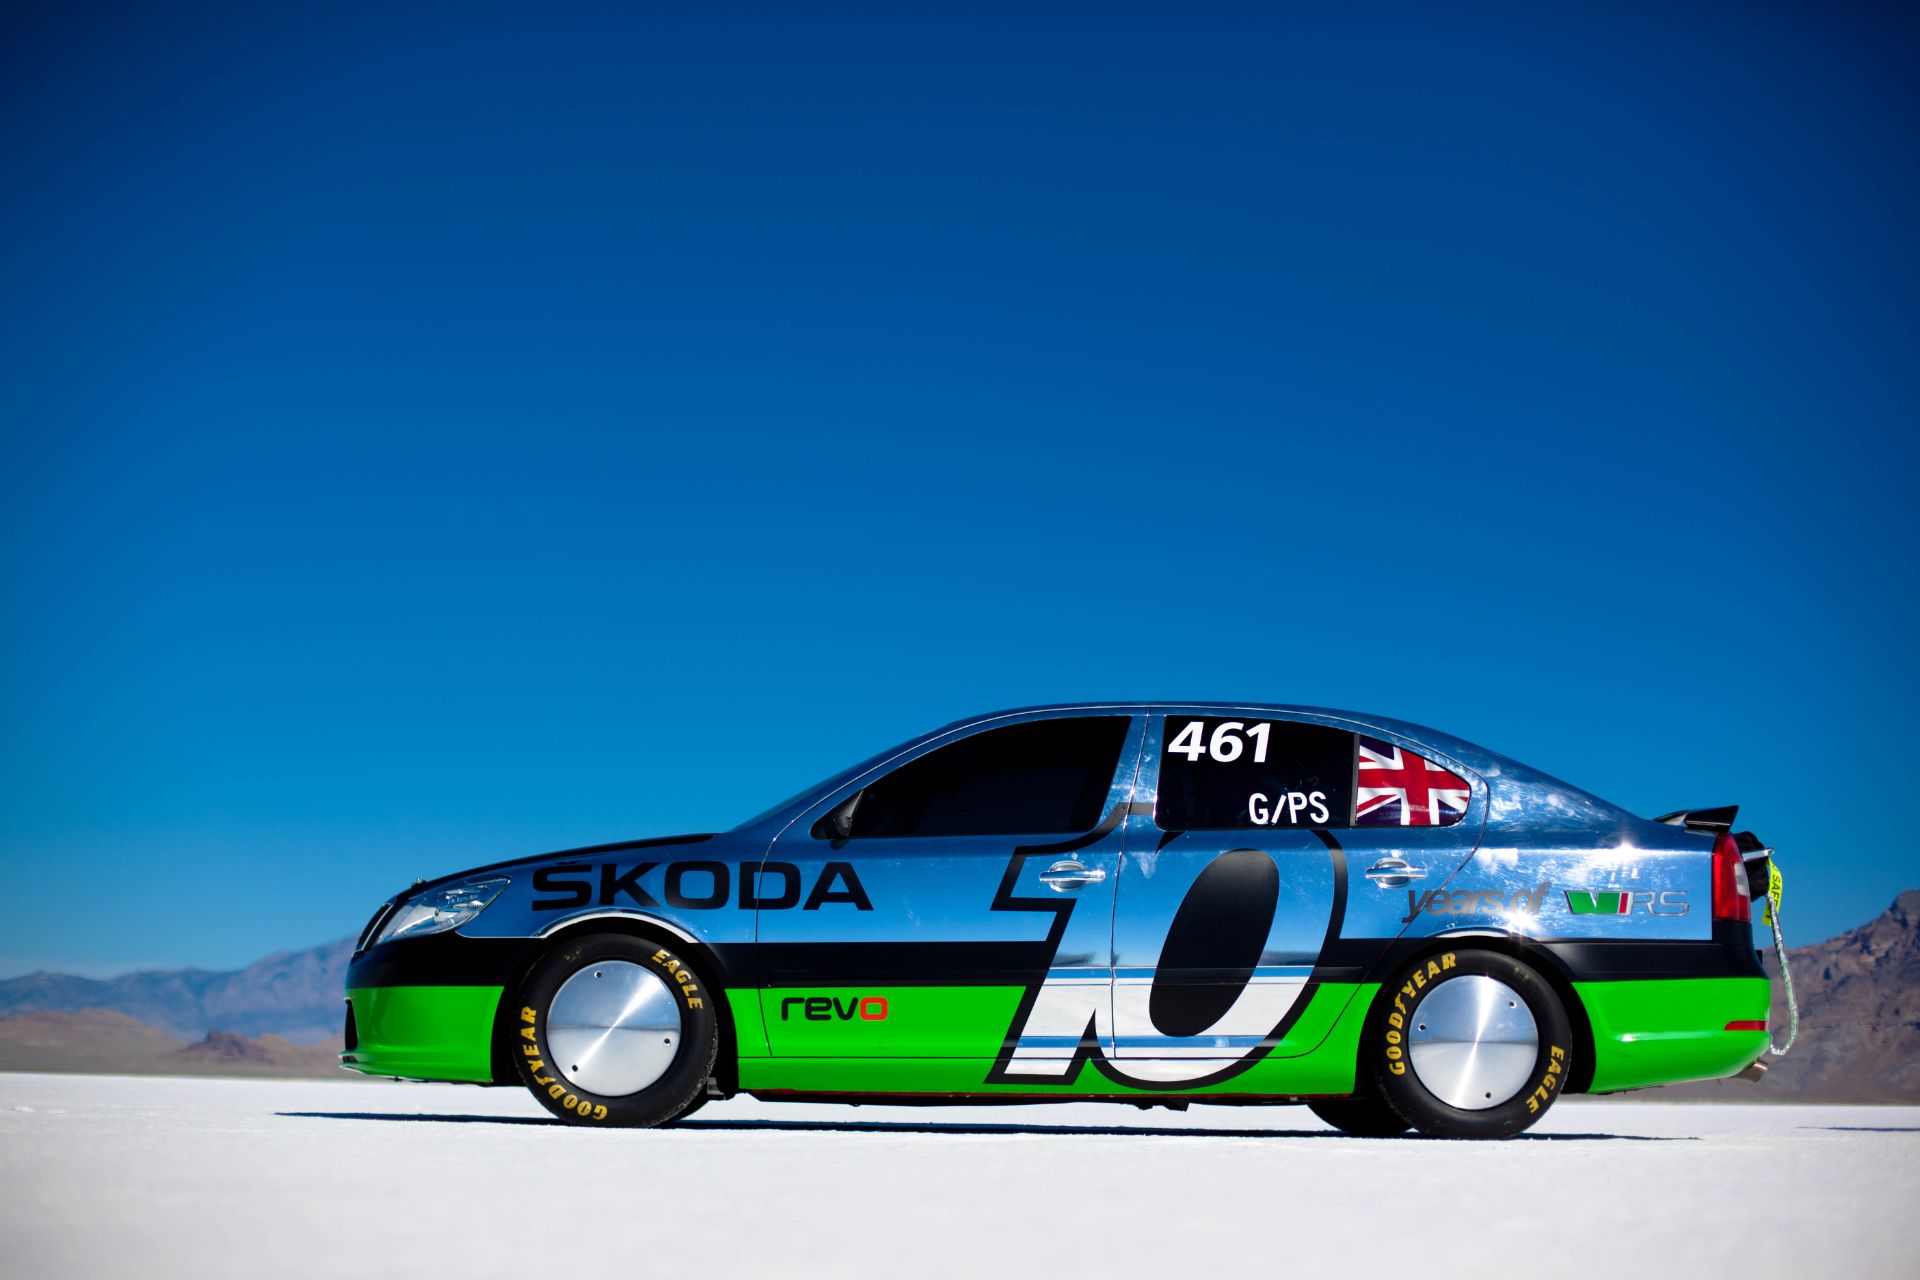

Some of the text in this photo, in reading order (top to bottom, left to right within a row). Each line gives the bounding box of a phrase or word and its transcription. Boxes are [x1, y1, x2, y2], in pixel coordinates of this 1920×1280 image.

[1167, 721, 1271, 763] 461
[1249, 791, 1330, 825] G/PS
[1402, 889, 1504, 924] years
[1511, 881, 1553, 916] of
[652, 949, 703, 1010] EAGLE
[781, 996, 889, 1021] revo
[1386, 952, 1457, 1076] GOODYEAR
[520, 1006, 608, 1121] GOODYEAR
[1526, 1045, 1565, 1114] EAGLE
